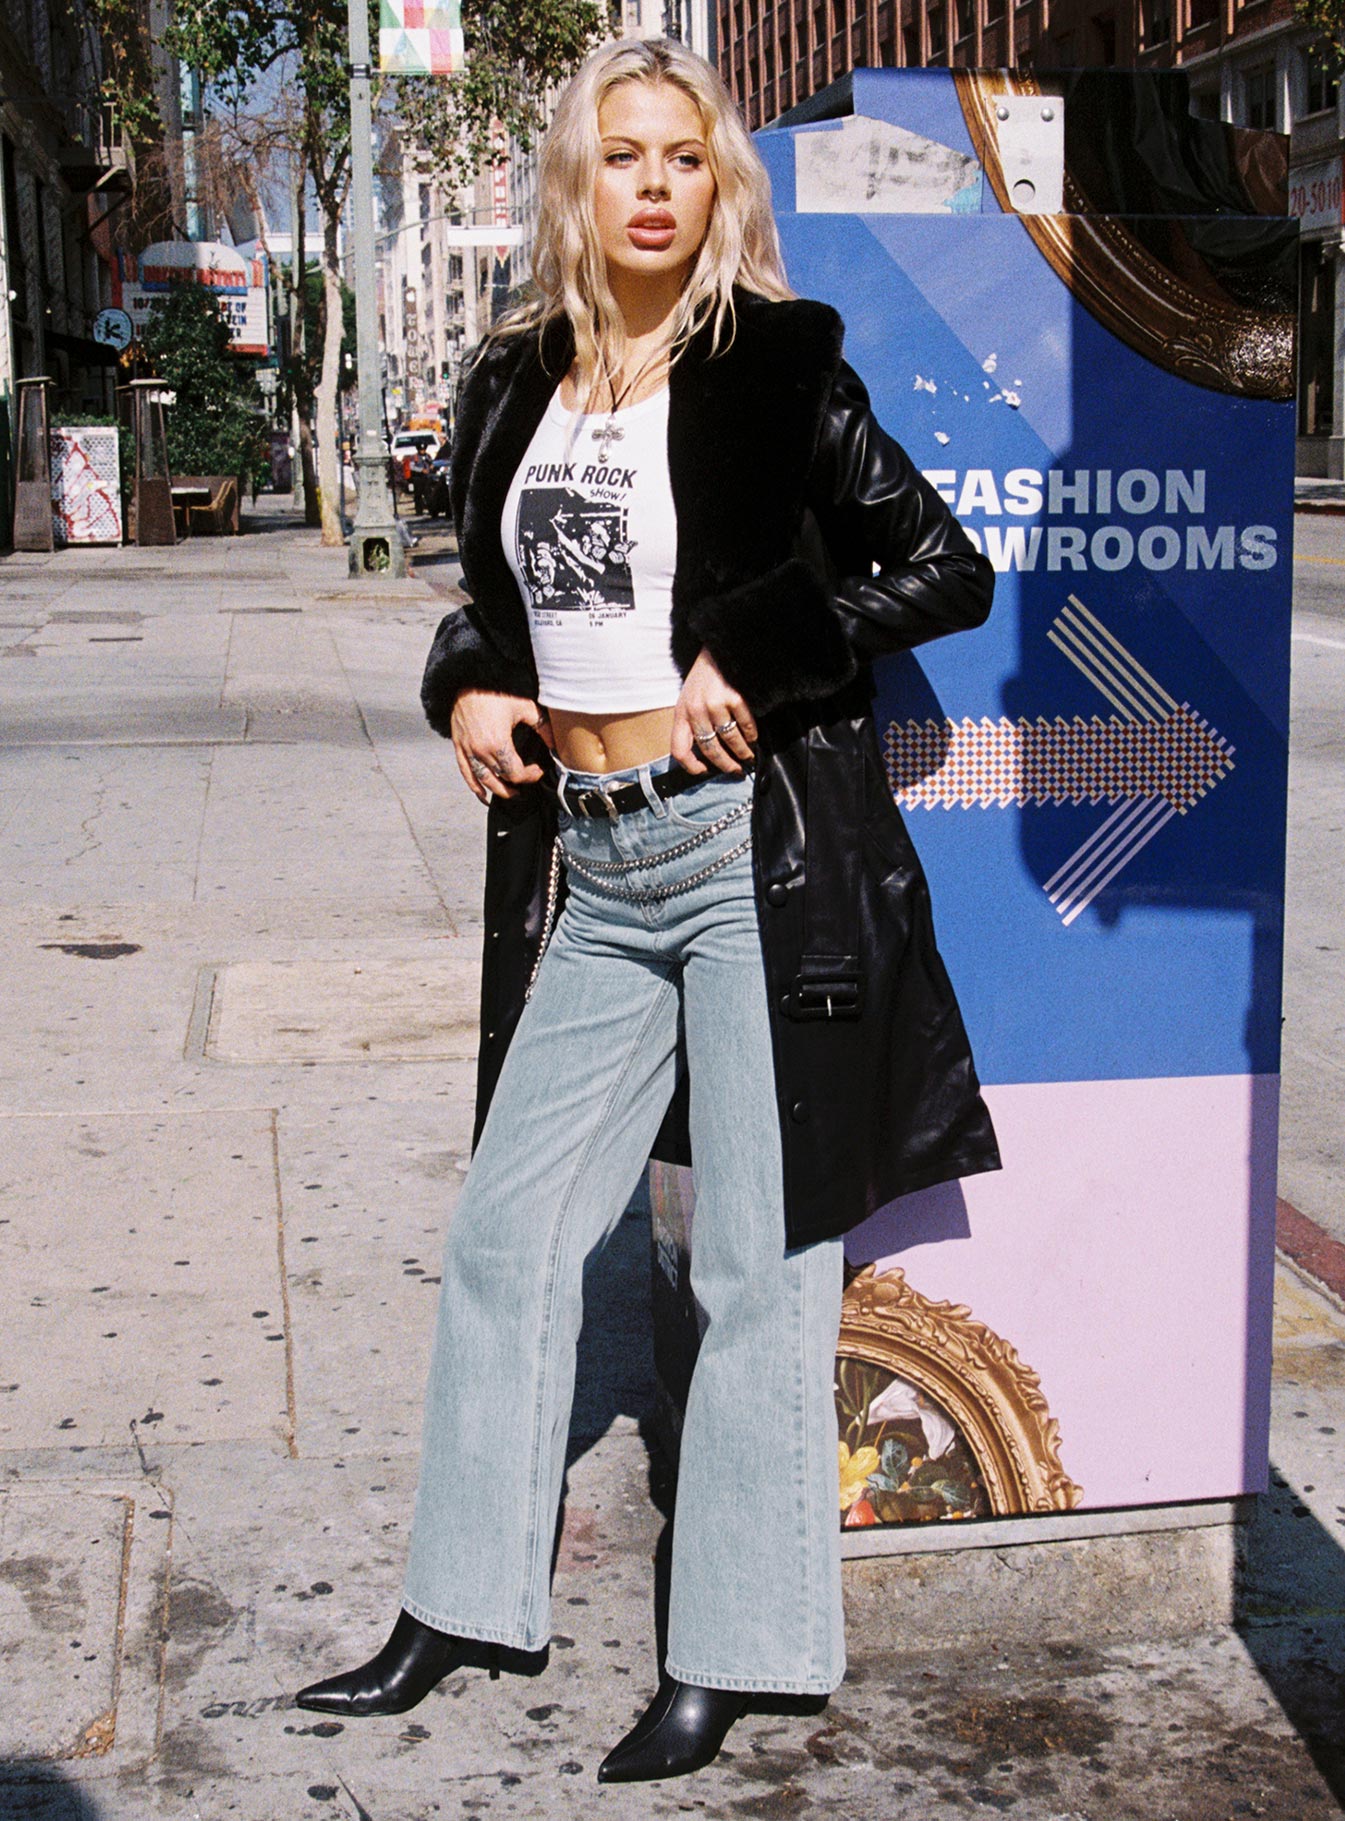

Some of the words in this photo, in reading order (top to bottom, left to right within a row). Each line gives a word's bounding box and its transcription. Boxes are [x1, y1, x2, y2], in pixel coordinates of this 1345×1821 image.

[524, 463, 577, 484] PUNK
[581, 465, 637, 489] ROCK
[921, 468, 1206, 516] FASHION
[958, 525, 1278, 572] WROOMS
[598, 611, 627, 619] JANUARY
